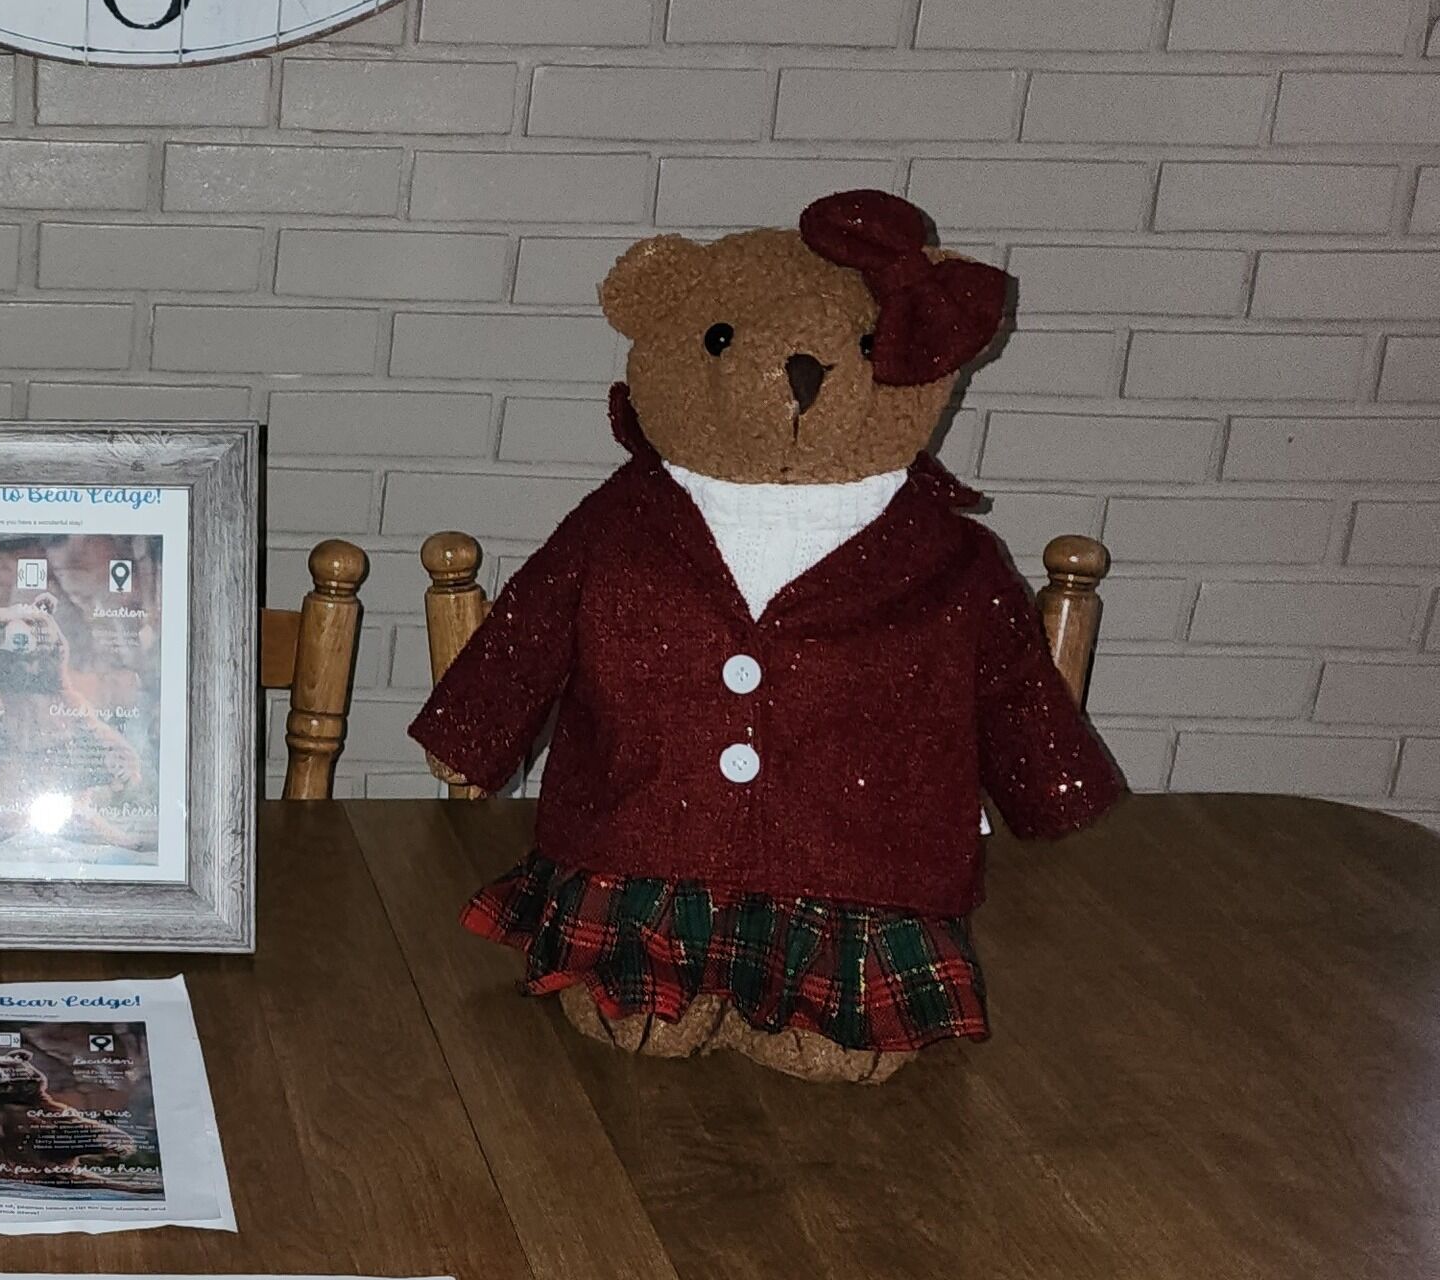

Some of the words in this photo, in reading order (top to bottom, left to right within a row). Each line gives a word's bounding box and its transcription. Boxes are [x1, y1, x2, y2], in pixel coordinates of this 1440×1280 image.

[28, 487, 82, 503] Bear
[0, 995, 58, 1008] Bear
[61, 995, 140, 1010] Ledge!
